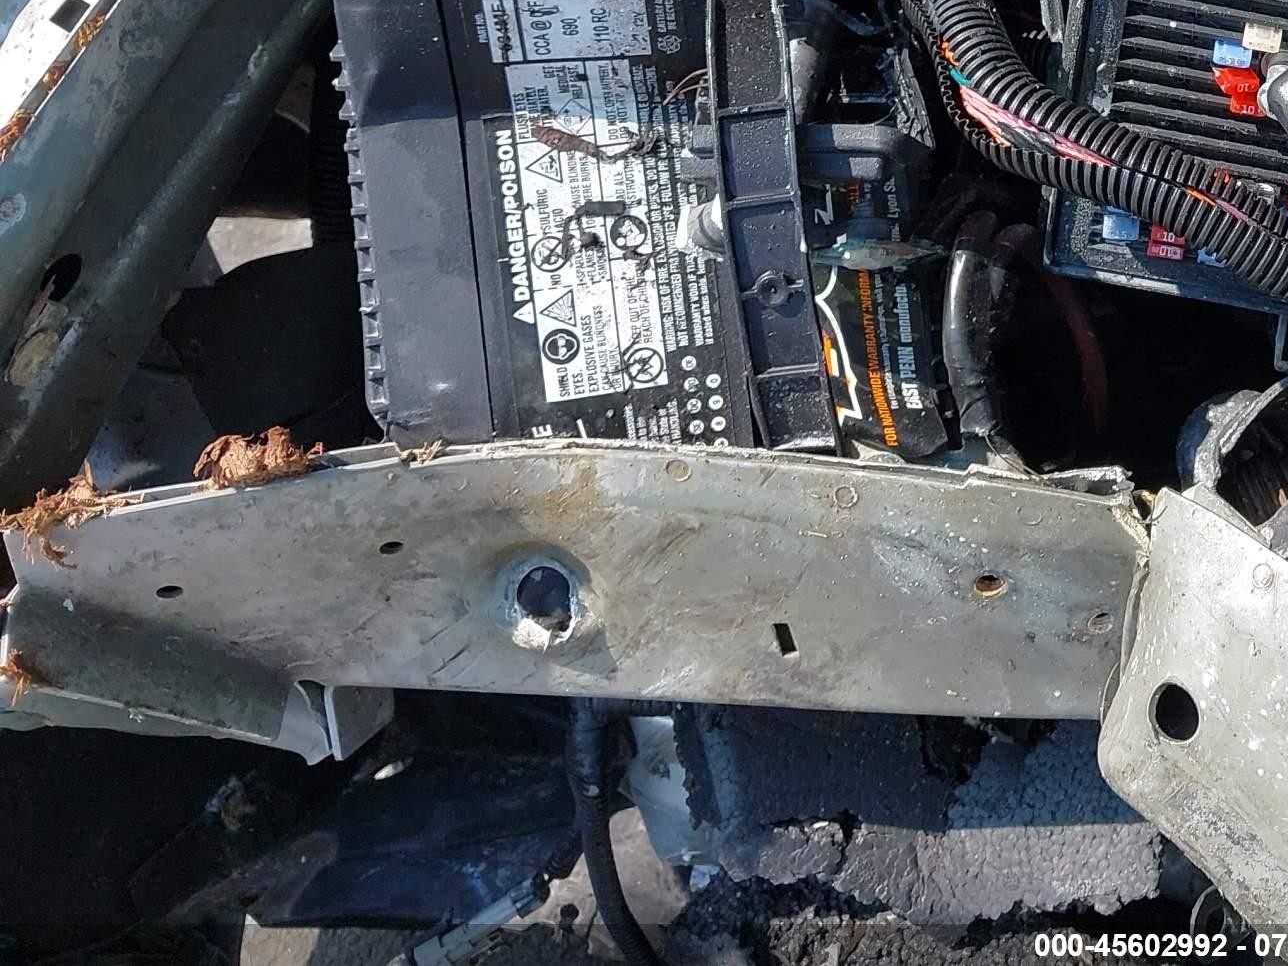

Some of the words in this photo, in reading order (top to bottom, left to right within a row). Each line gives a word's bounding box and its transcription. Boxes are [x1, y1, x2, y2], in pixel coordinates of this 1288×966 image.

[530, 20, 552, 31] @
[561, 18, 580, 36] 690
[590, 8, 608, 24] RC
[632, 10, 645, 28] 12V
[532, 33, 552, 56] CCA
[542, 66, 555, 79] GET
[555, 65, 570, 94] MEDICAL
[512, 93, 527, 112] EYES
[1241, 104, 1255, 115] 10
[516, 113, 530, 140] FLUSH
[605, 110, 618, 126] NOT
[616, 107, 628, 124] NOT
[607, 128, 619, 141] DO
[660, 171, 672, 203] FOLLOW
[496, 129, 532, 302] DANGER/POISON
[536, 188, 551, 231] SULFURIC
[886, 194, 901, 219] Lyon
[1162, 231, 1175, 242] 10
[550, 274, 561, 287] NO
[626, 293, 637, 304] OF
[592, 305, 607, 348] BLINDNESS
[628, 306, 639, 323] OUT
[690, 302, 705, 347] WARRANTY
[580, 314, 593, 343] GASES
[640, 315, 652, 343] REACH
[862, 313, 880, 370] WARRANTY
[583, 344, 600, 393] EXPLOSIVE
[596, 349, 610, 373] CAUSE
[897, 346, 917, 379] PENN
[556, 366, 570, 399] SHIELD
[869, 370, 893, 427] NATIONWIDE
[900, 381, 923, 410] EAST
[883, 427, 898, 447] FOR
